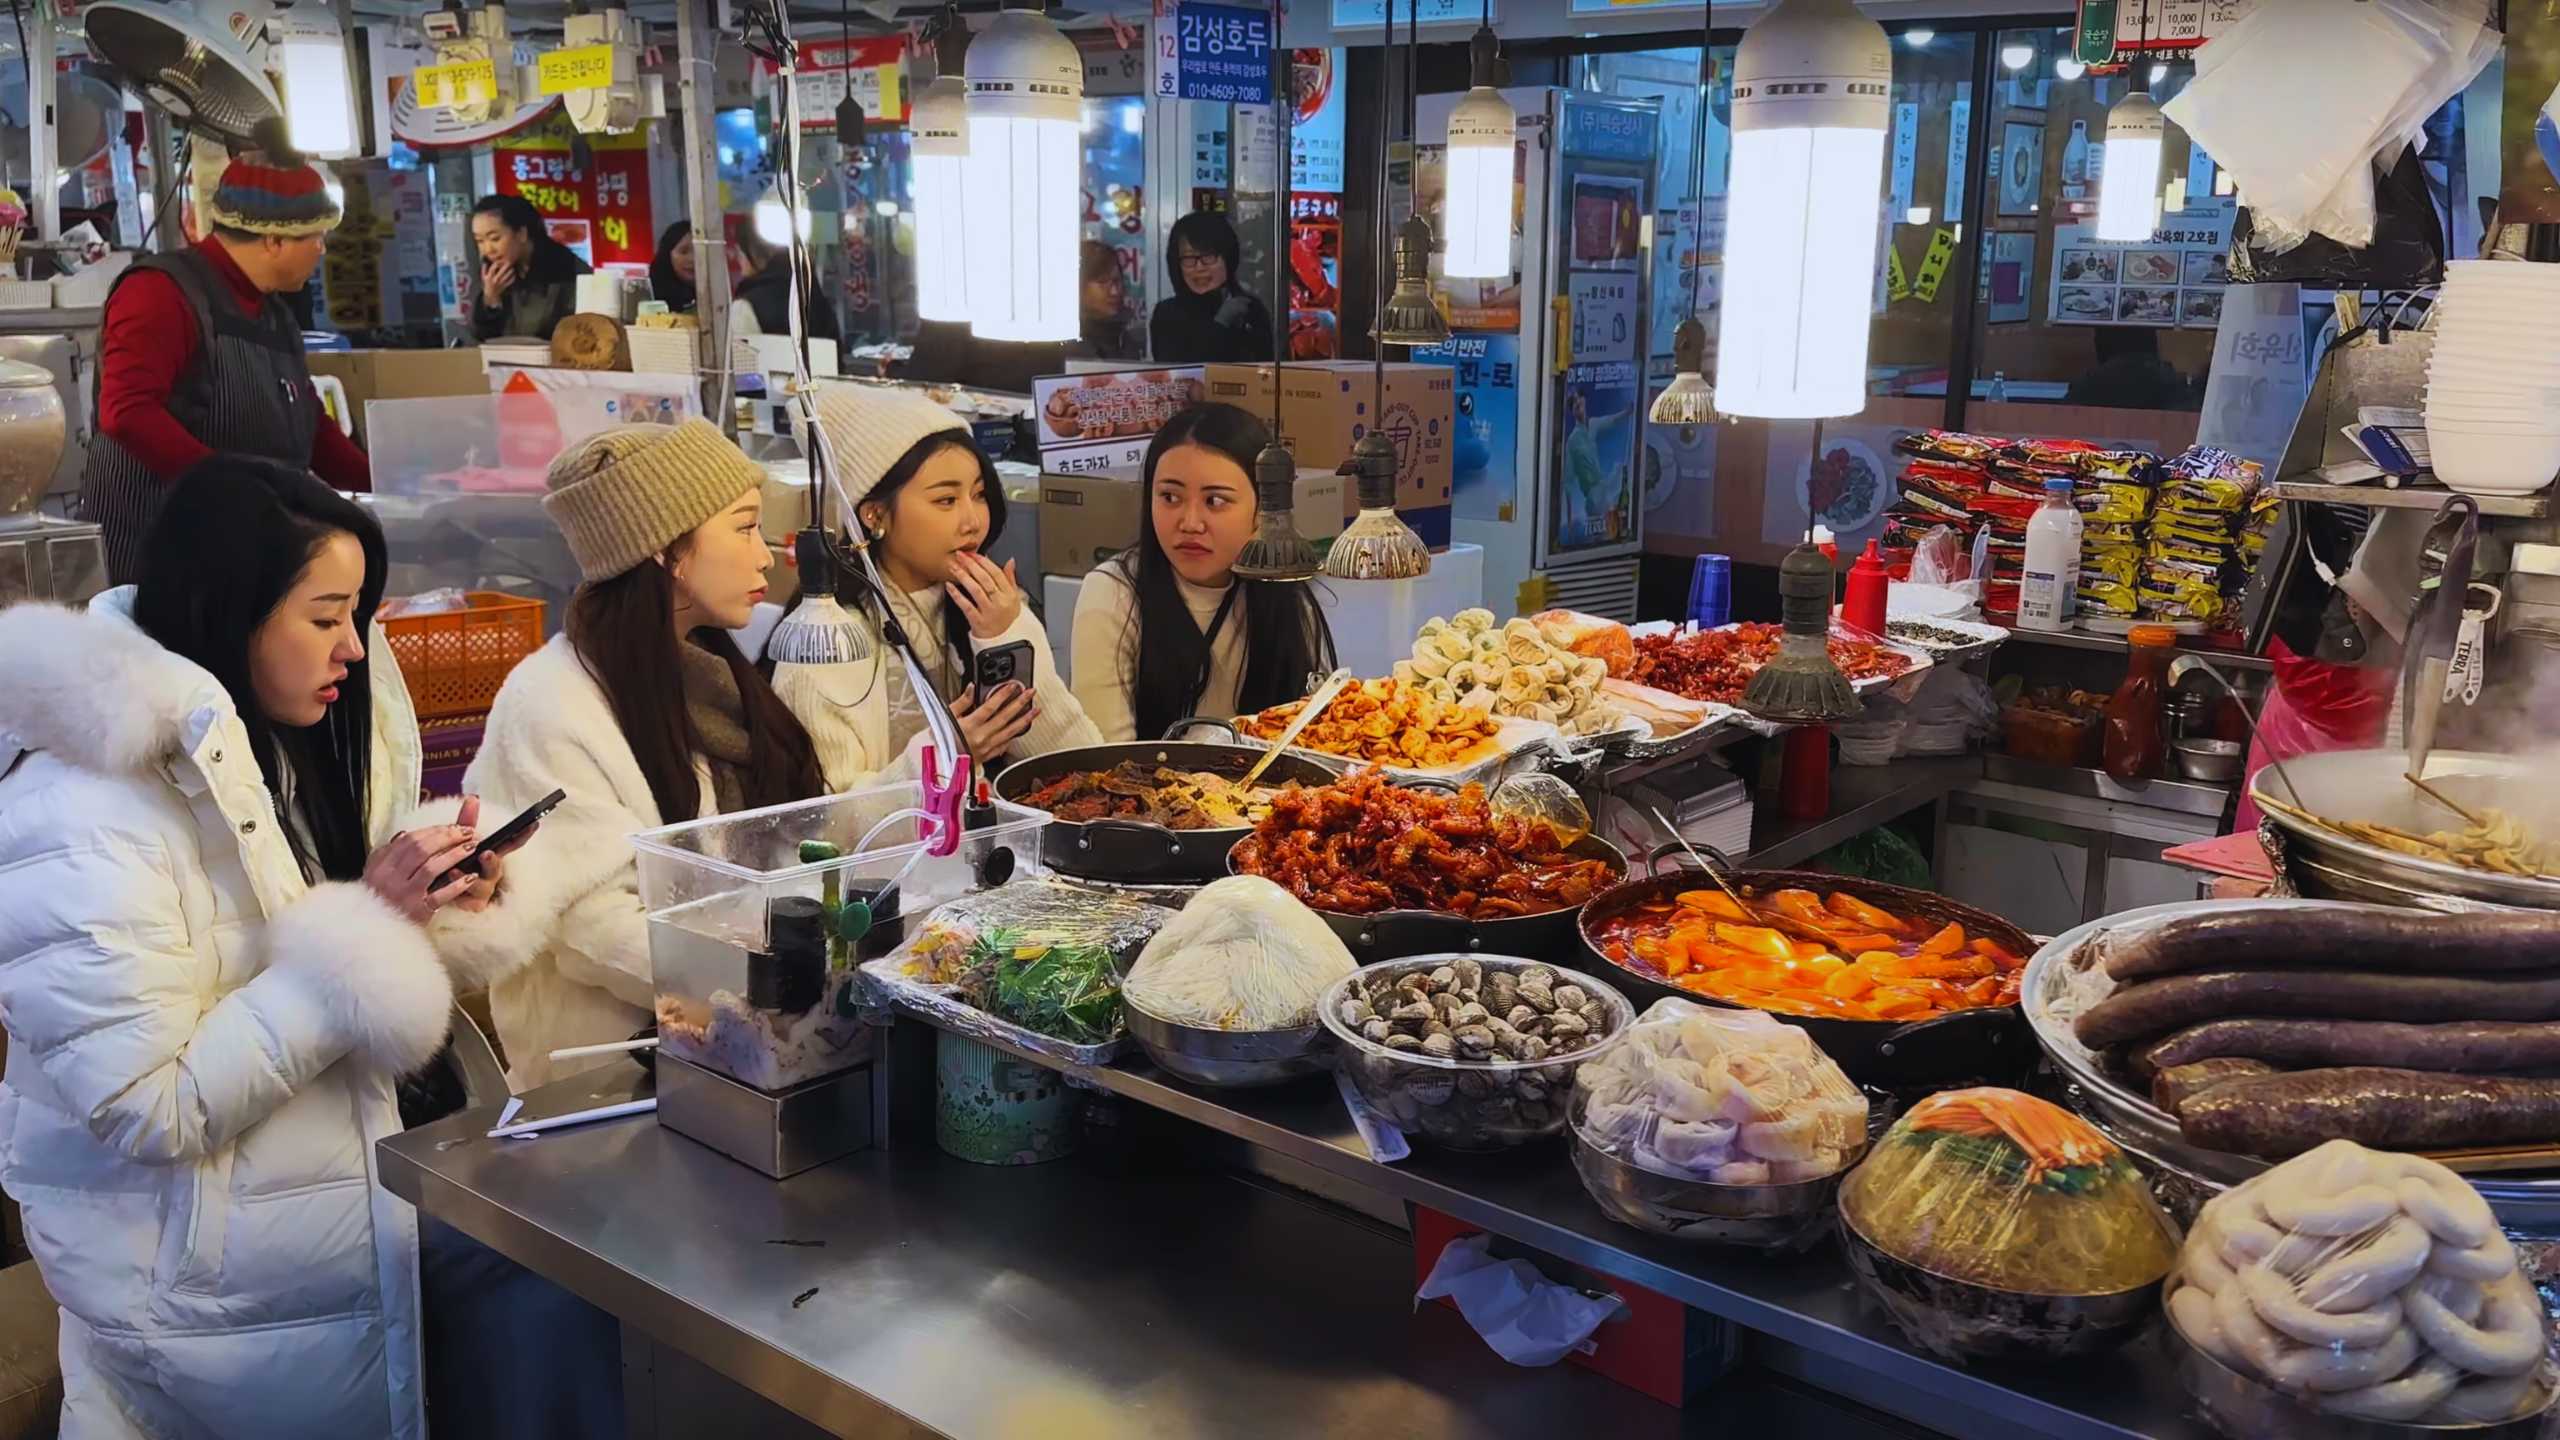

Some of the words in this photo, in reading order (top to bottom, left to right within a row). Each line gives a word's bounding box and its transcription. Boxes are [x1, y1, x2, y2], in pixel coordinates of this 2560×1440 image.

[2125, 15, 2154, 26] 13,00
[2167, 13, 2198, 24] 10,000
[1181, 15, 1268, 58] 감성호두
[2171, 26, 2196, 37] 7,000
[1160, 34, 1176, 59] 12
[1159, 72, 1176, 95] 호
[2186, 230, 2219, 246] 2호점
[1457, 339, 1489, 359] 반전
[2451, 640, 2473, 675] TERRA
